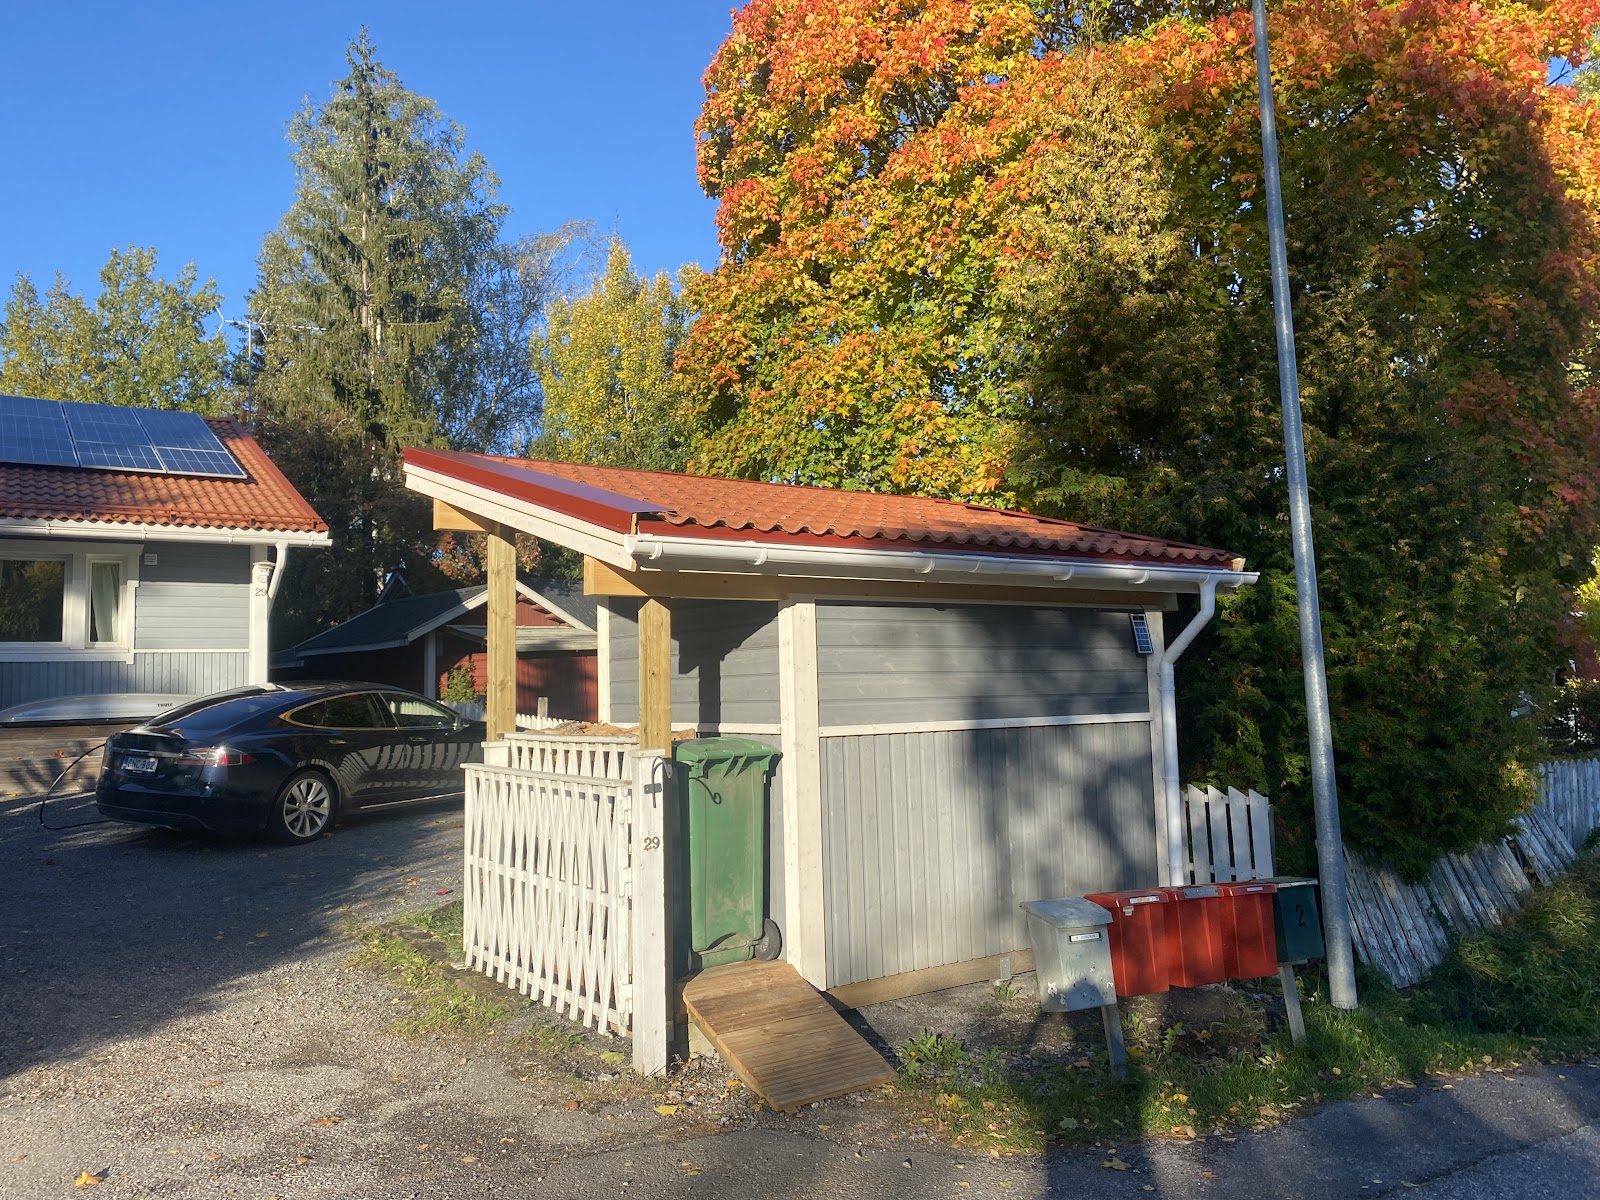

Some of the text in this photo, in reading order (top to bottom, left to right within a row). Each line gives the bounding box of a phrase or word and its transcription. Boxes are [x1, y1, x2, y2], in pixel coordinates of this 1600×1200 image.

[255, 588, 268, 596] 29
[644, 836, 660, 850] 29
[1296, 904, 1307, 927] 2
